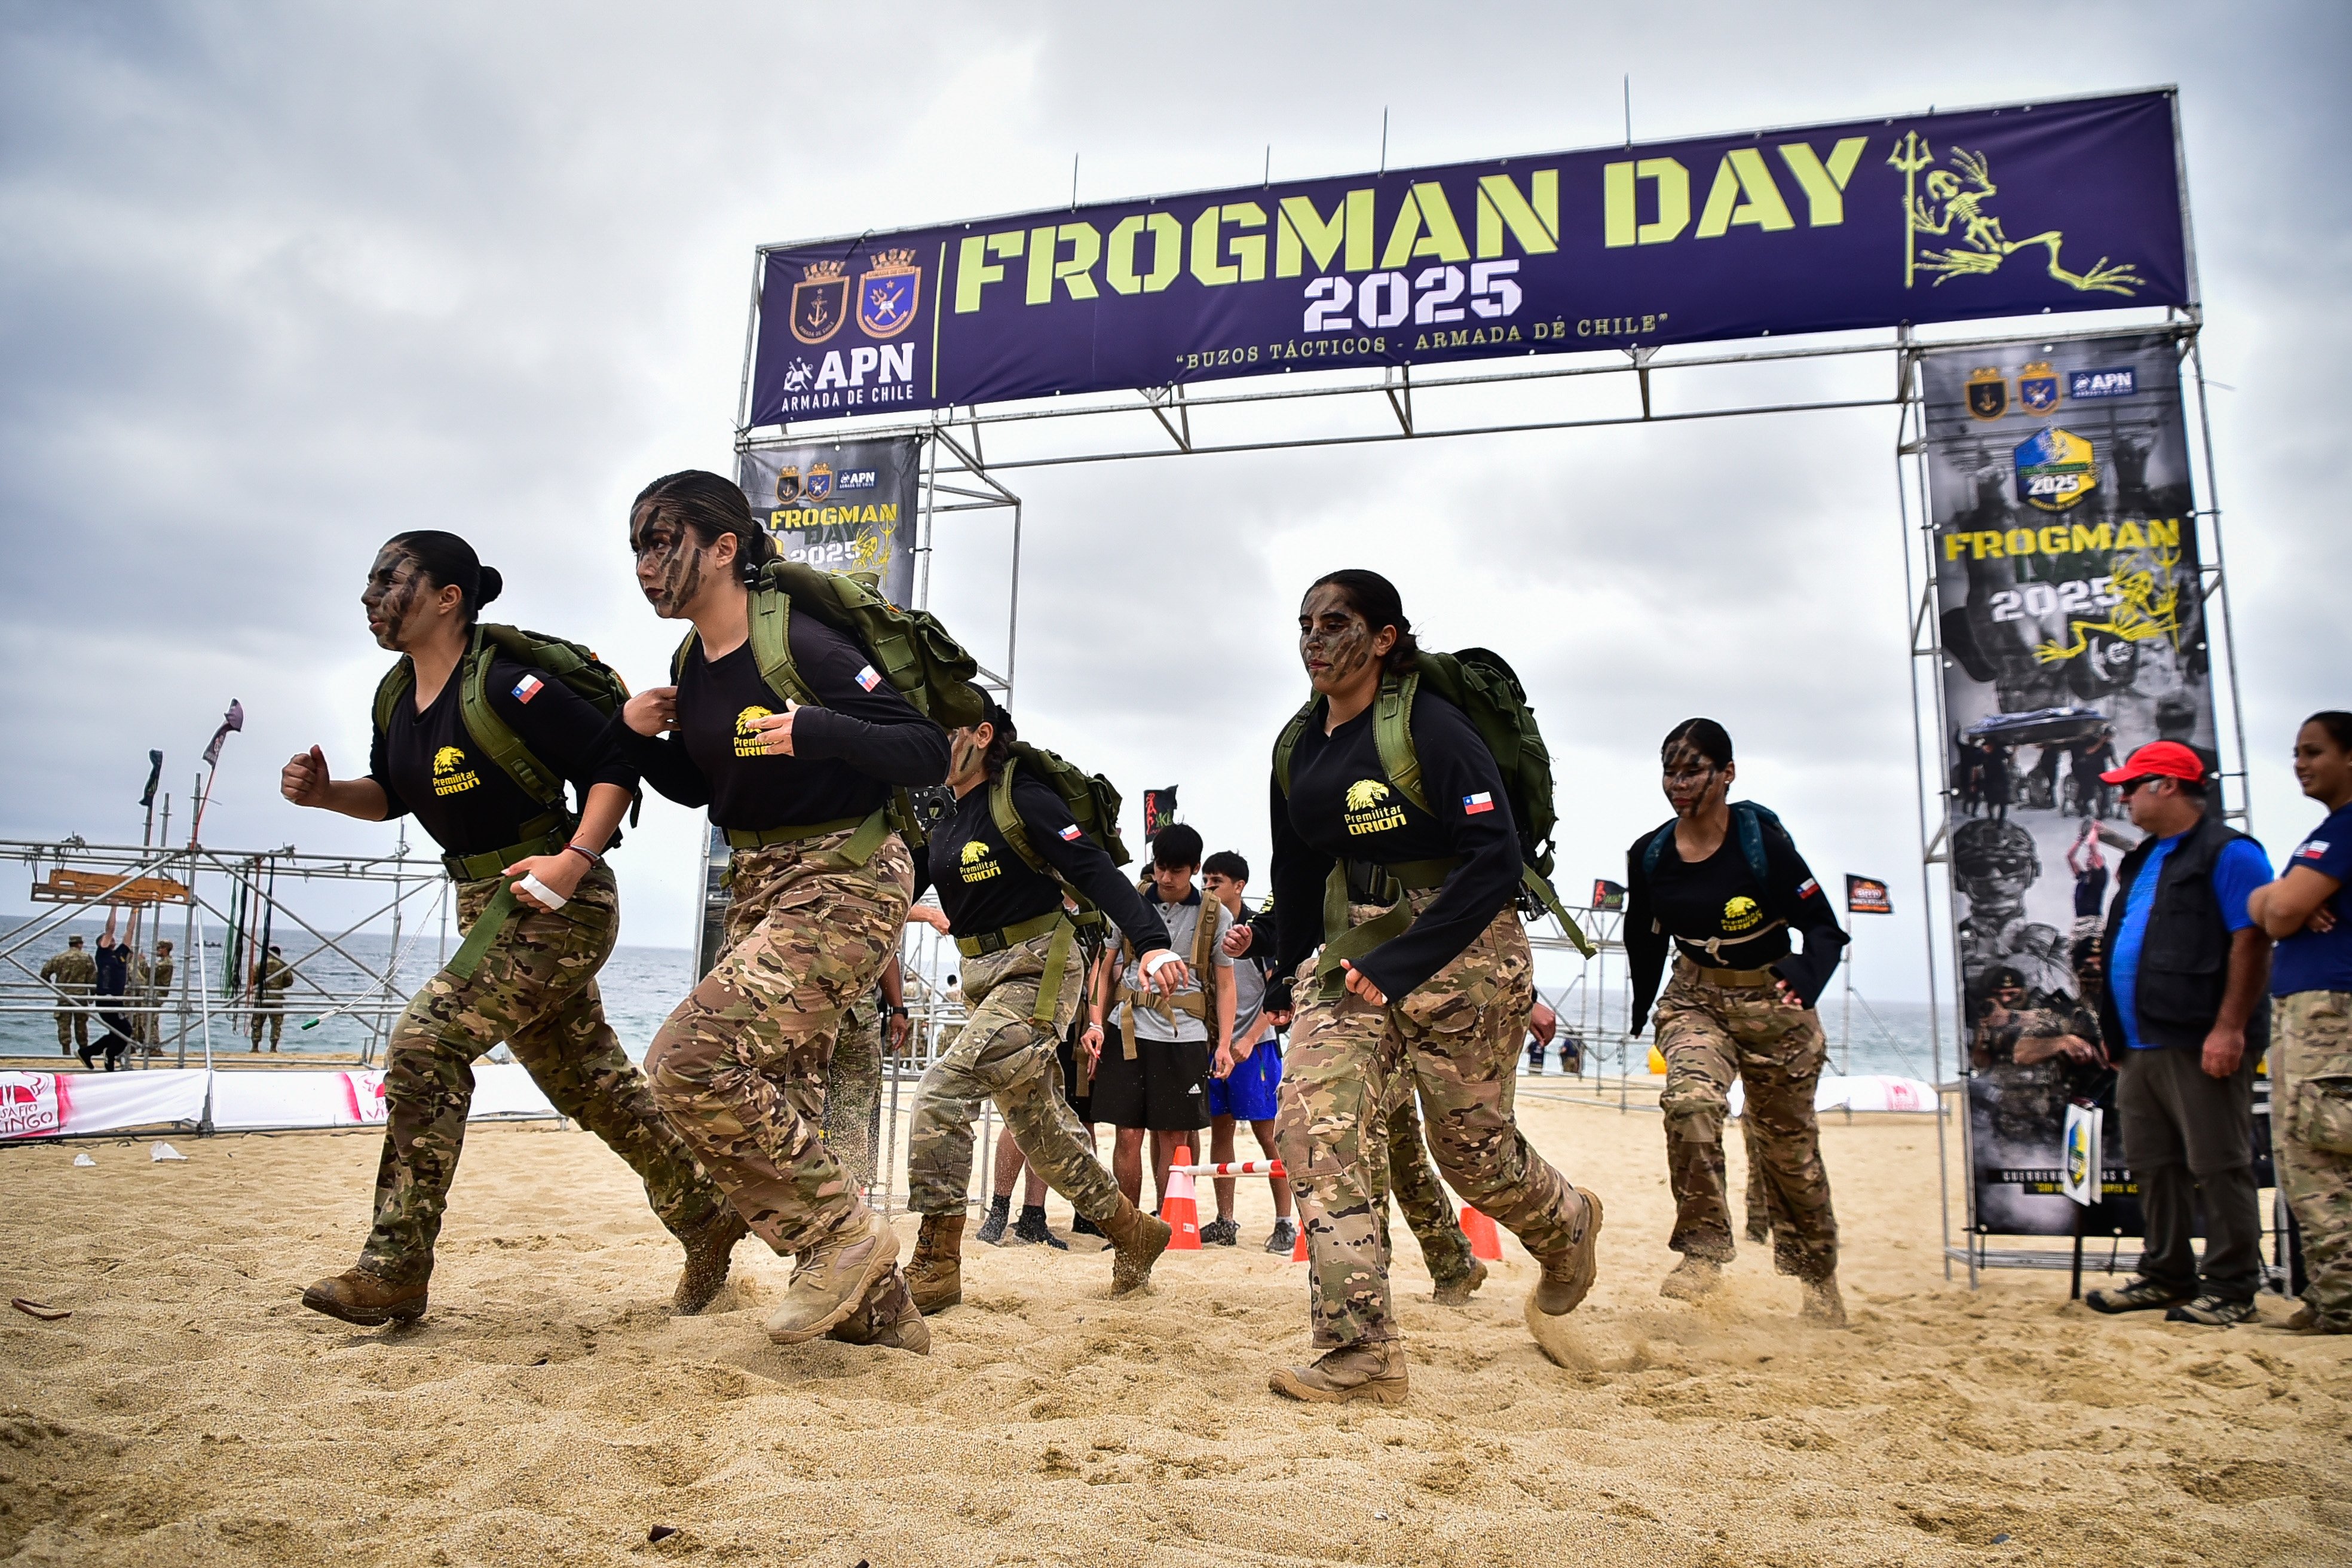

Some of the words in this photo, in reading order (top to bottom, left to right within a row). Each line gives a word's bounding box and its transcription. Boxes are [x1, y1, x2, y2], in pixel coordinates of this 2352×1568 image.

[955, 169, 1558, 313] FROGMAN
[1604, 136, 1869, 247] DAY
[1304, 259, 1523, 333] 2025
[1270, 336, 1386, 359] TÁCTICOS
[1414, 324, 1522, 350] ARMADA
[814, 342, 915, 391] APN
[2091, 372, 2132, 389] APN
[782, 391, 840, 412] ARMADA
[847, 389, 863, 405] DE
[872, 384, 913, 403] CHILE
[850, 471, 875, 483] APN
[770, 503, 897, 529] FROGMAN
[1944, 517, 2180, 561] FROGMAN
[790, 540, 860, 565] 2025
[1989, 576, 2124, 622] 2025
[433, 770, 475, 787] Premilitar
[435, 777, 480, 796] ORION
[1344, 805, 1401, 824] Premilitar
[1348, 813, 1407, 835] ORION
[959, 859, 997, 874] Premilitar
[962, 866, 1002, 883] ORION
[0, 1104, 38, 1119] SAFIO
[0, 1111, 53, 1134] INGO
